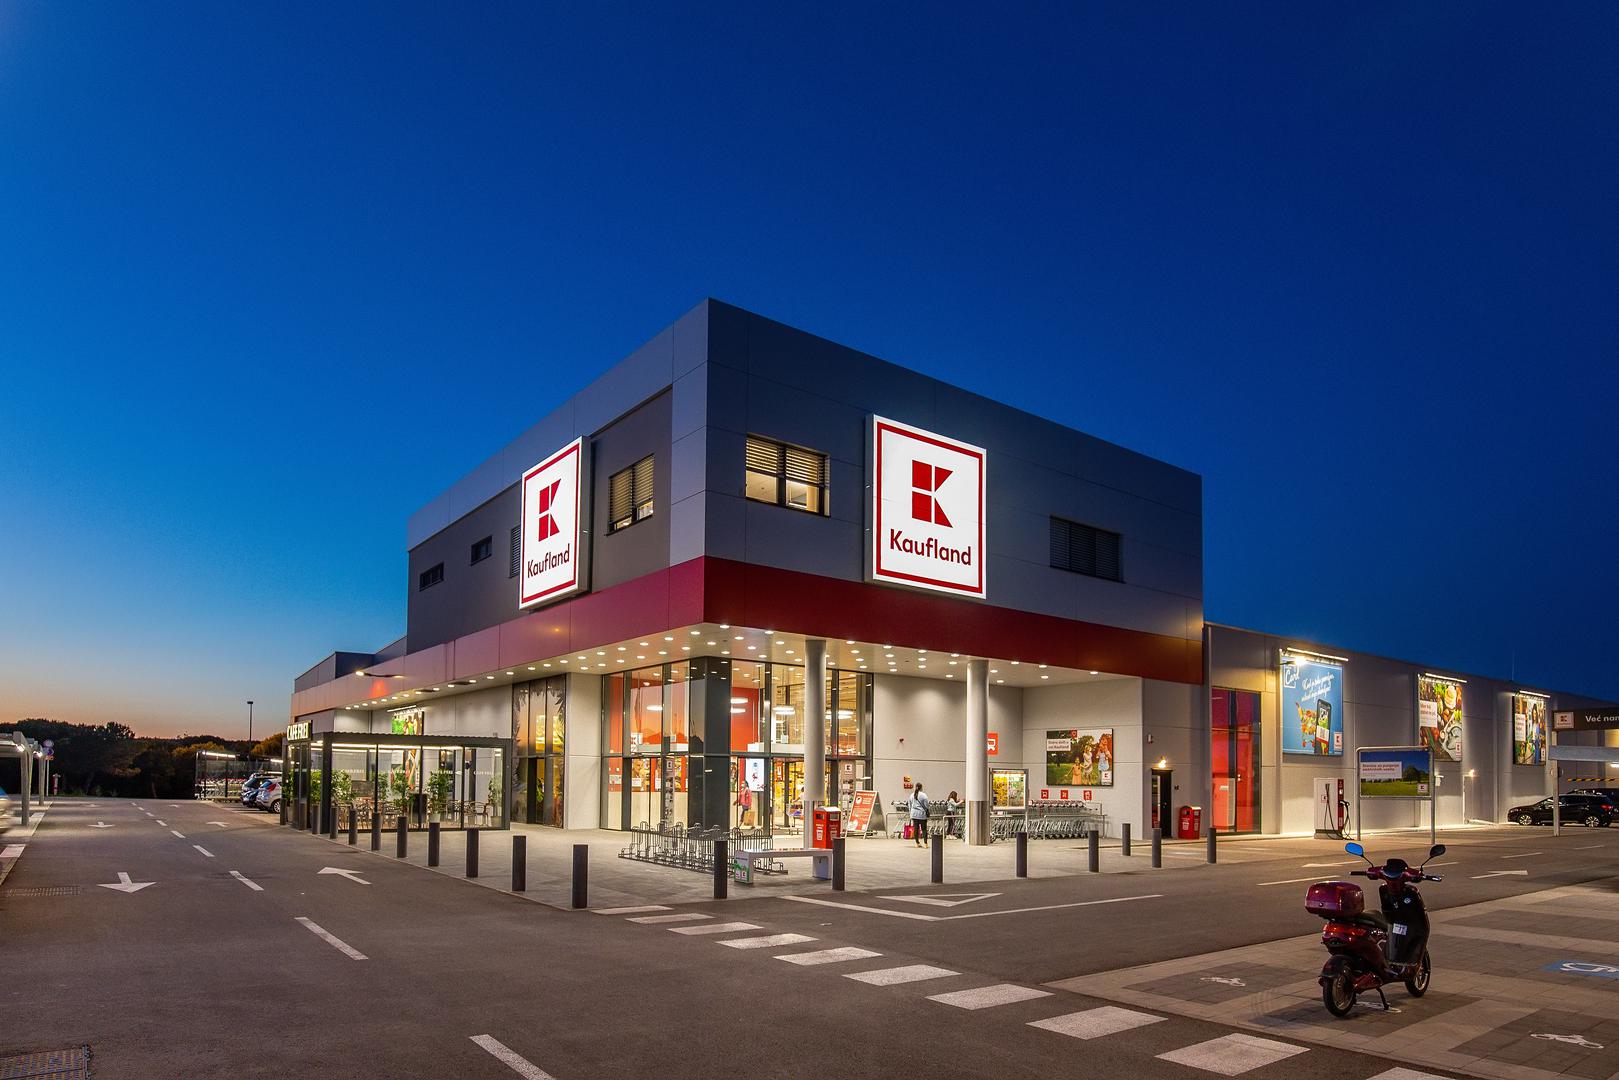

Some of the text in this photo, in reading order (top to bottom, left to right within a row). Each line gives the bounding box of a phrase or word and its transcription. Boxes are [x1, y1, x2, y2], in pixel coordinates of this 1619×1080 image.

[890, 528, 971, 565] Kaufland
[528, 543, 570, 578] Kaufland
[1585, 714, 1601, 722] Već
[287, 724, 298, 740] CAFE
